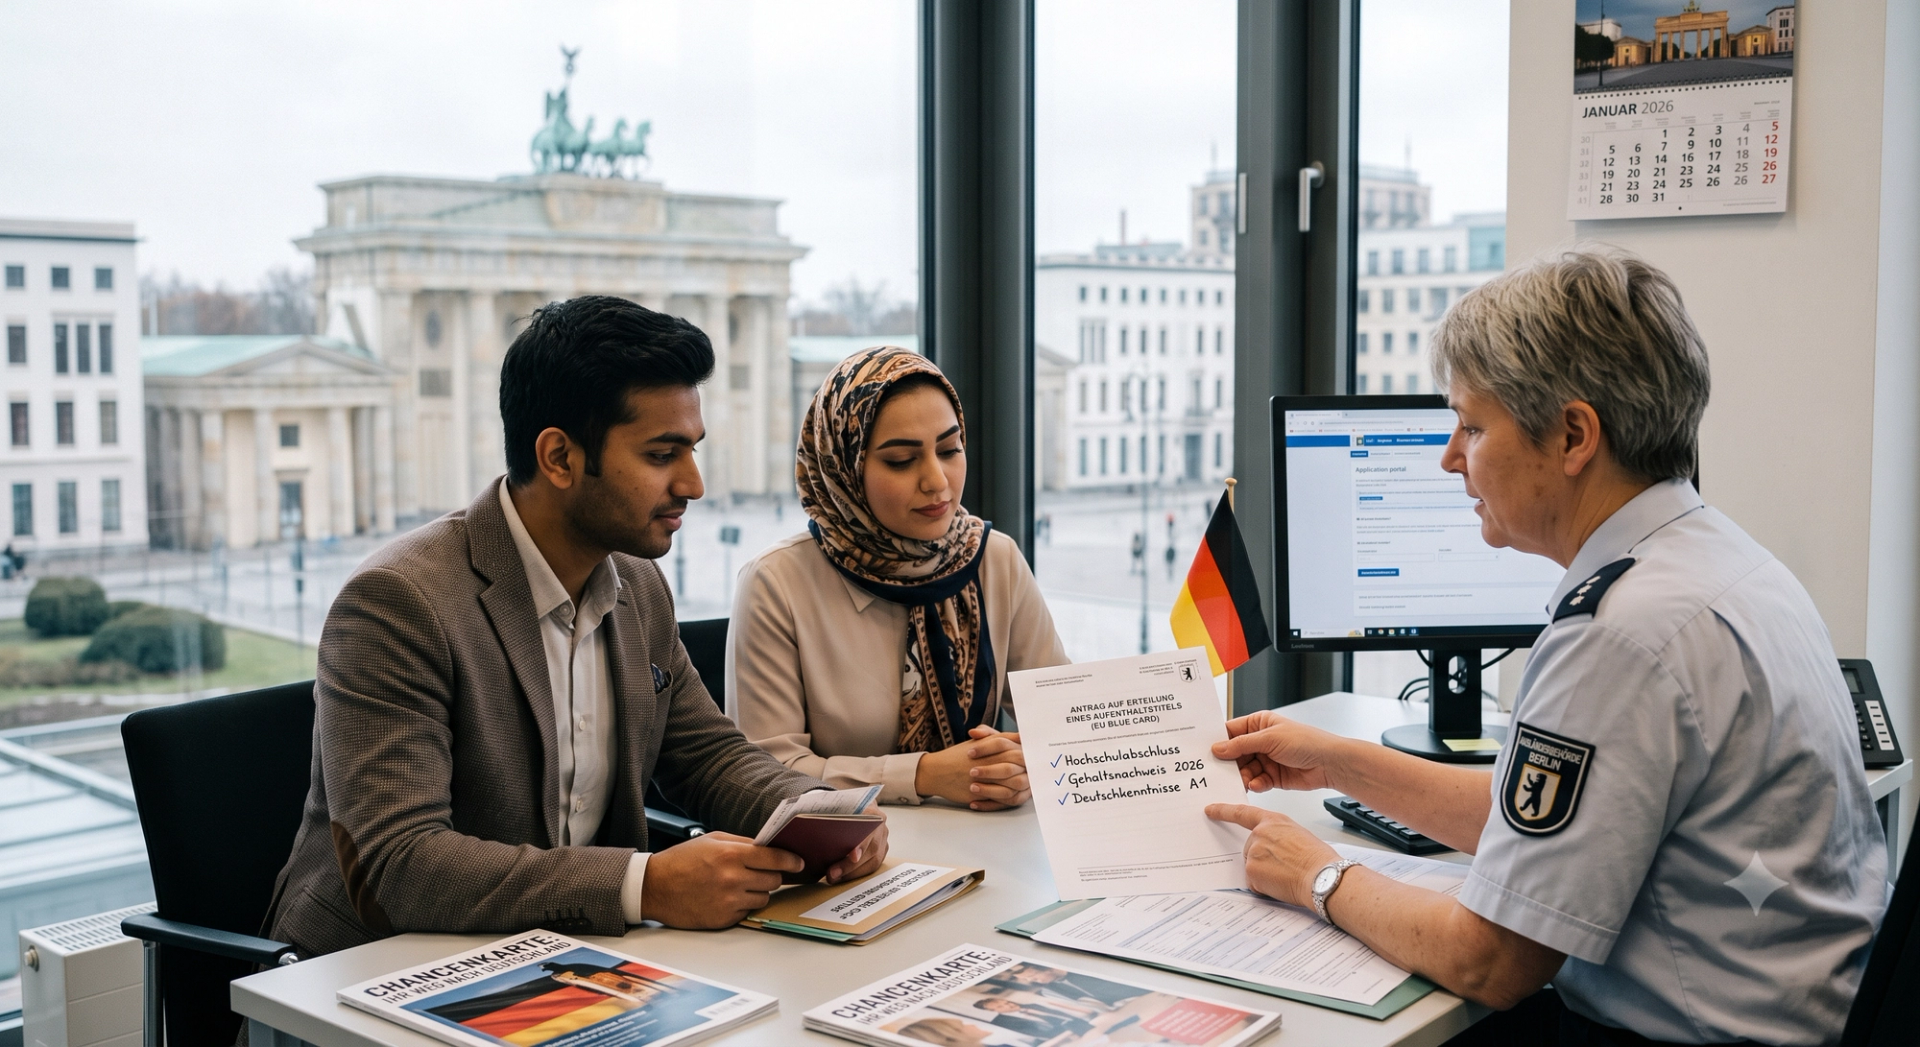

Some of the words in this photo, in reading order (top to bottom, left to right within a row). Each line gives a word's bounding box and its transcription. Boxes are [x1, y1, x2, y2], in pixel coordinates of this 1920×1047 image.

[1582, 103, 1637, 118] JANUAR
[1641, 100, 1674, 114] 2026
[1662, 129, 1667, 138] 1
[1688, 127, 1695, 136] 2
[1715, 125, 1722, 135] 3
[1743, 123, 1750, 133] 4
[1772, 121, 1779, 131] 5
[1609, 145, 1615, 154] 5
[1635, 143, 1641, 152] 6
[1662, 142, 1667, 151] 7
[1688, 140, 1695, 149] 9
[1709, 138, 1722, 148] 10
[1737, 136, 1748, 146] 11
[1765, 134, 1778, 144] 12
[1603, 158, 1615, 166] 12
[1629, 156, 1640, 165] 13
[1655, 154, 1667, 164] 14
[1682, 152, 1694, 162] 16
[1709, 151, 1721, 161] 17
[1736, 149, 1749, 159] 18
[1764, 148, 1778, 158] 19
[1603, 170, 1614, 179] 19
[1627, 169, 1640, 178] 20
[1654, 167, 1666, 176] 21
[1680, 166, 1693, 175] 23
[1707, 164, 1720, 174] 24
[1734, 162, 1748, 172] 25
[1762, 161, 1777, 171] 26
[1601, 182, 1612, 192] 21
[1626, 181, 1639, 190] 23
[1653, 180, 1666, 189] 24
[1680, 178, 1692, 188] 25
[1706, 177, 1720, 187] 26
[1734, 175, 1748, 185] 26
[1762, 174, 1776, 184] 27
[1600, 195, 1613, 204] 28
[1626, 194, 1639, 203] 30
[1652, 193, 1664, 202] 31
[1066, 713, 1091, 724] EINES
[1093, 702, 1183, 720] AUFENTHALTSTITELS
[1070, 703, 1106, 714] ANTRAG
[1108, 700, 1124, 709] AUF
[1126, 694, 1175, 706] ERTEILUNG
[1091, 722, 1106, 731] (EU
[1108, 718, 1130, 728] BLUE
[1133, 715, 1160, 725] CARD)
[1065, 744, 1180, 767] Hochschulabschluss
[1528, 751, 1562, 771] BERLIN
[1068, 765, 1167, 788] Gehaltsnachweis
[1174, 759, 1205, 772] 2026
[1072, 783, 1181, 804] Deutschkenntnisse
[1189, 777, 1208, 790] A1
[363, 935, 560, 997] CHANCENKARTE:
[382, 990, 413, 1004] IHR
[410, 981, 445, 996] WEG
[445, 969, 483, 986] NACH
[482, 941, 572, 973] DEUTSCHLAND
[831, 951, 997, 1019] CHANCENKARTE:
[856, 1013, 885, 1025] IHR
[882, 1002, 910, 1016] WEG
[906, 989, 941, 1005] NACH
[939, 956, 1013, 992] DEUTSCHLAND
